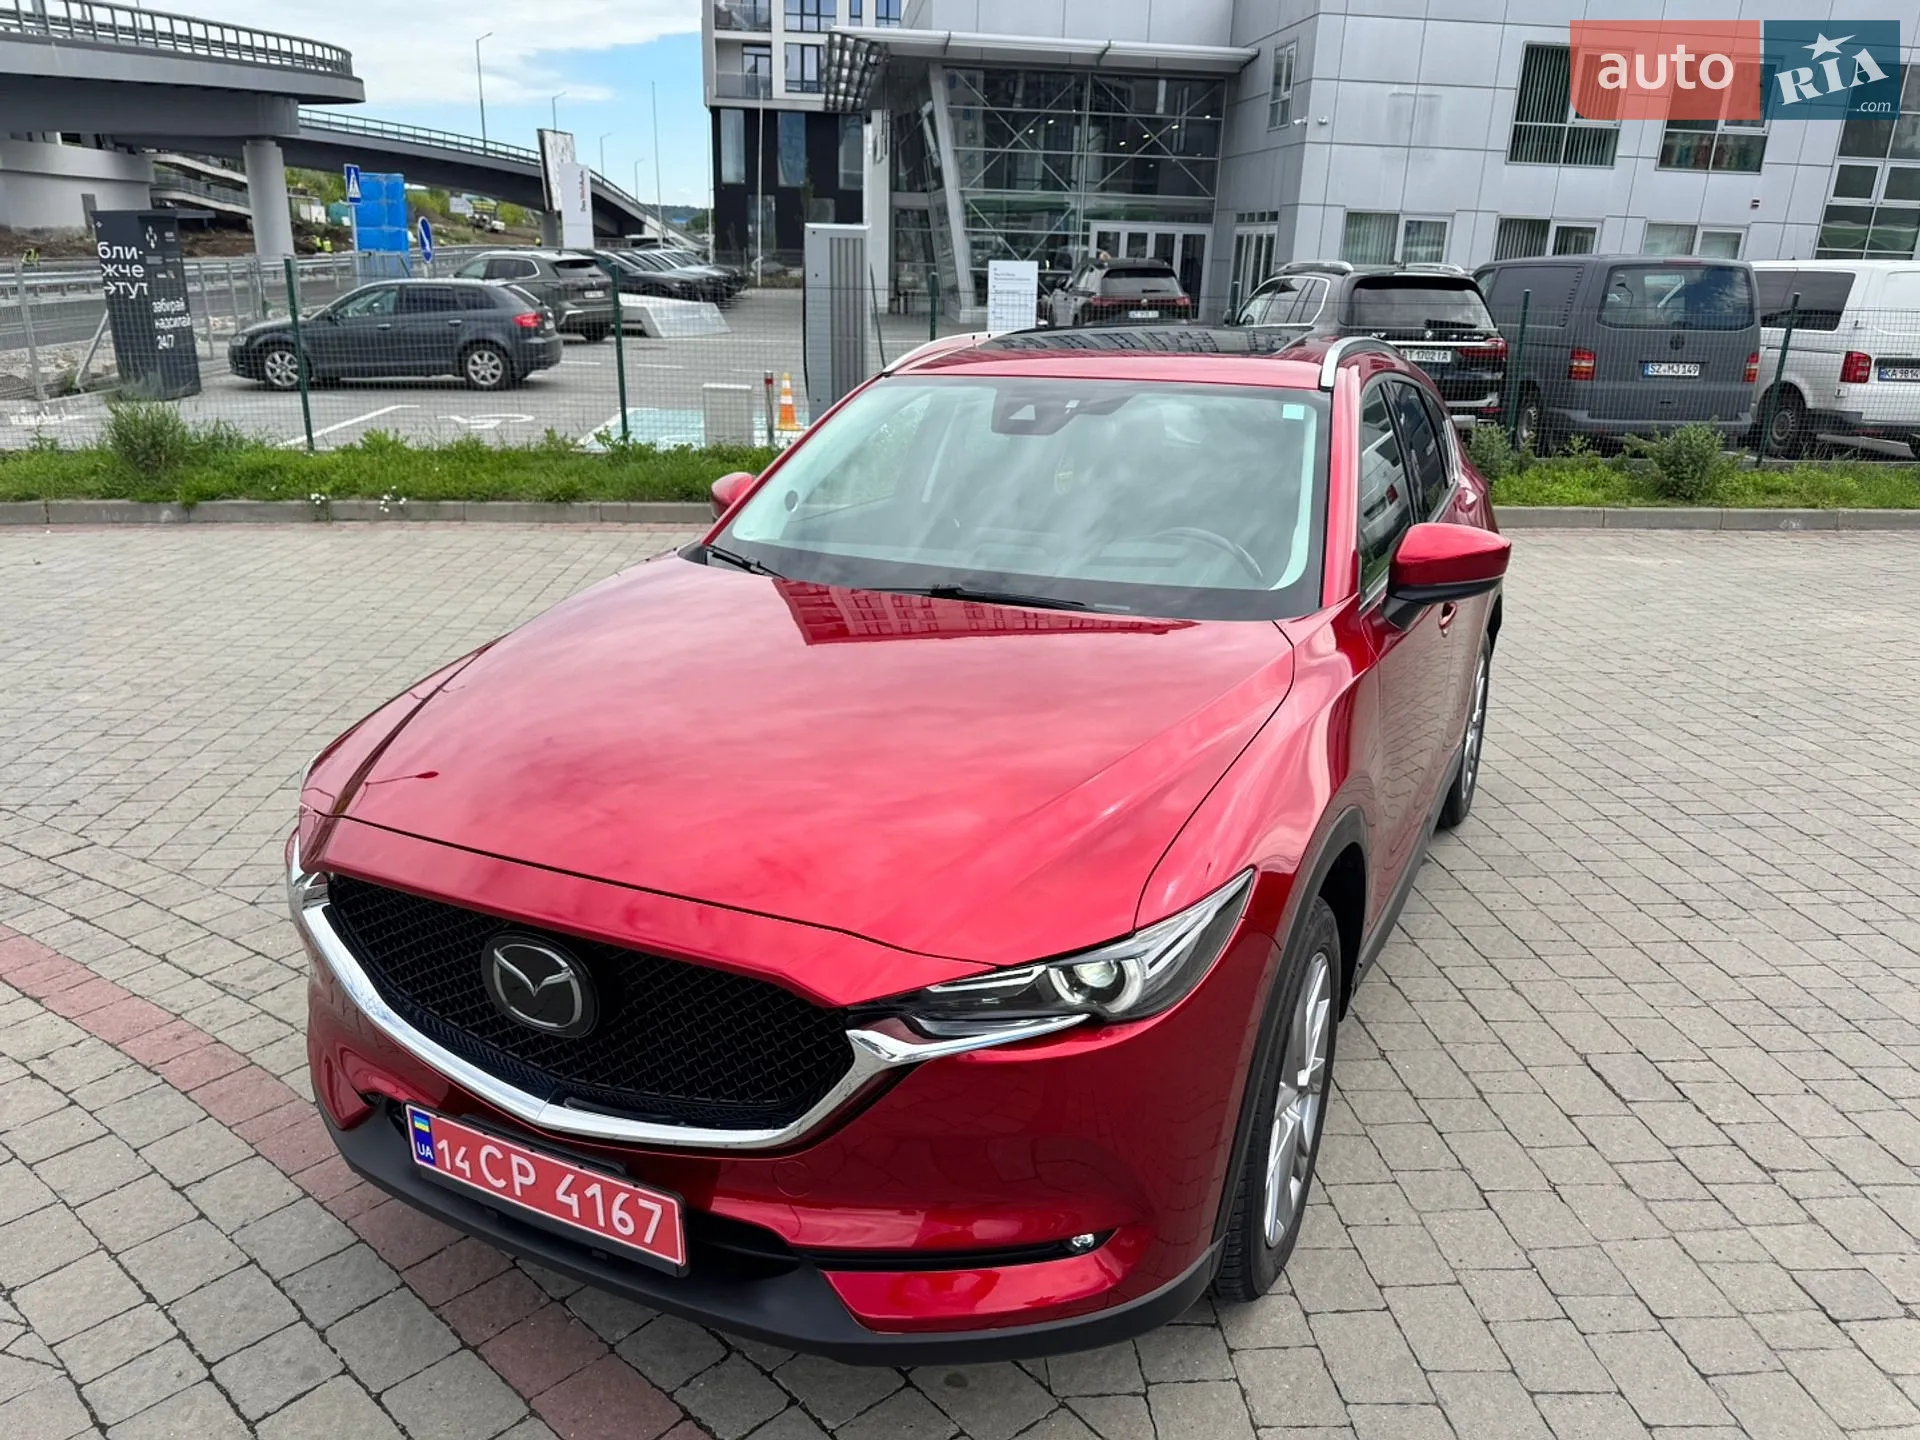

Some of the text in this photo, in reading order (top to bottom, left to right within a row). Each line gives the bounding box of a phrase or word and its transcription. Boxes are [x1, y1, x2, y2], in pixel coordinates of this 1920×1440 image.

[97, 242, 143, 259] бли-
[101, 263, 145, 278] жче
[115, 281, 149, 299] тут
[417, 1141, 434, 1159] UA
[555, 1173, 663, 1244] 4167
